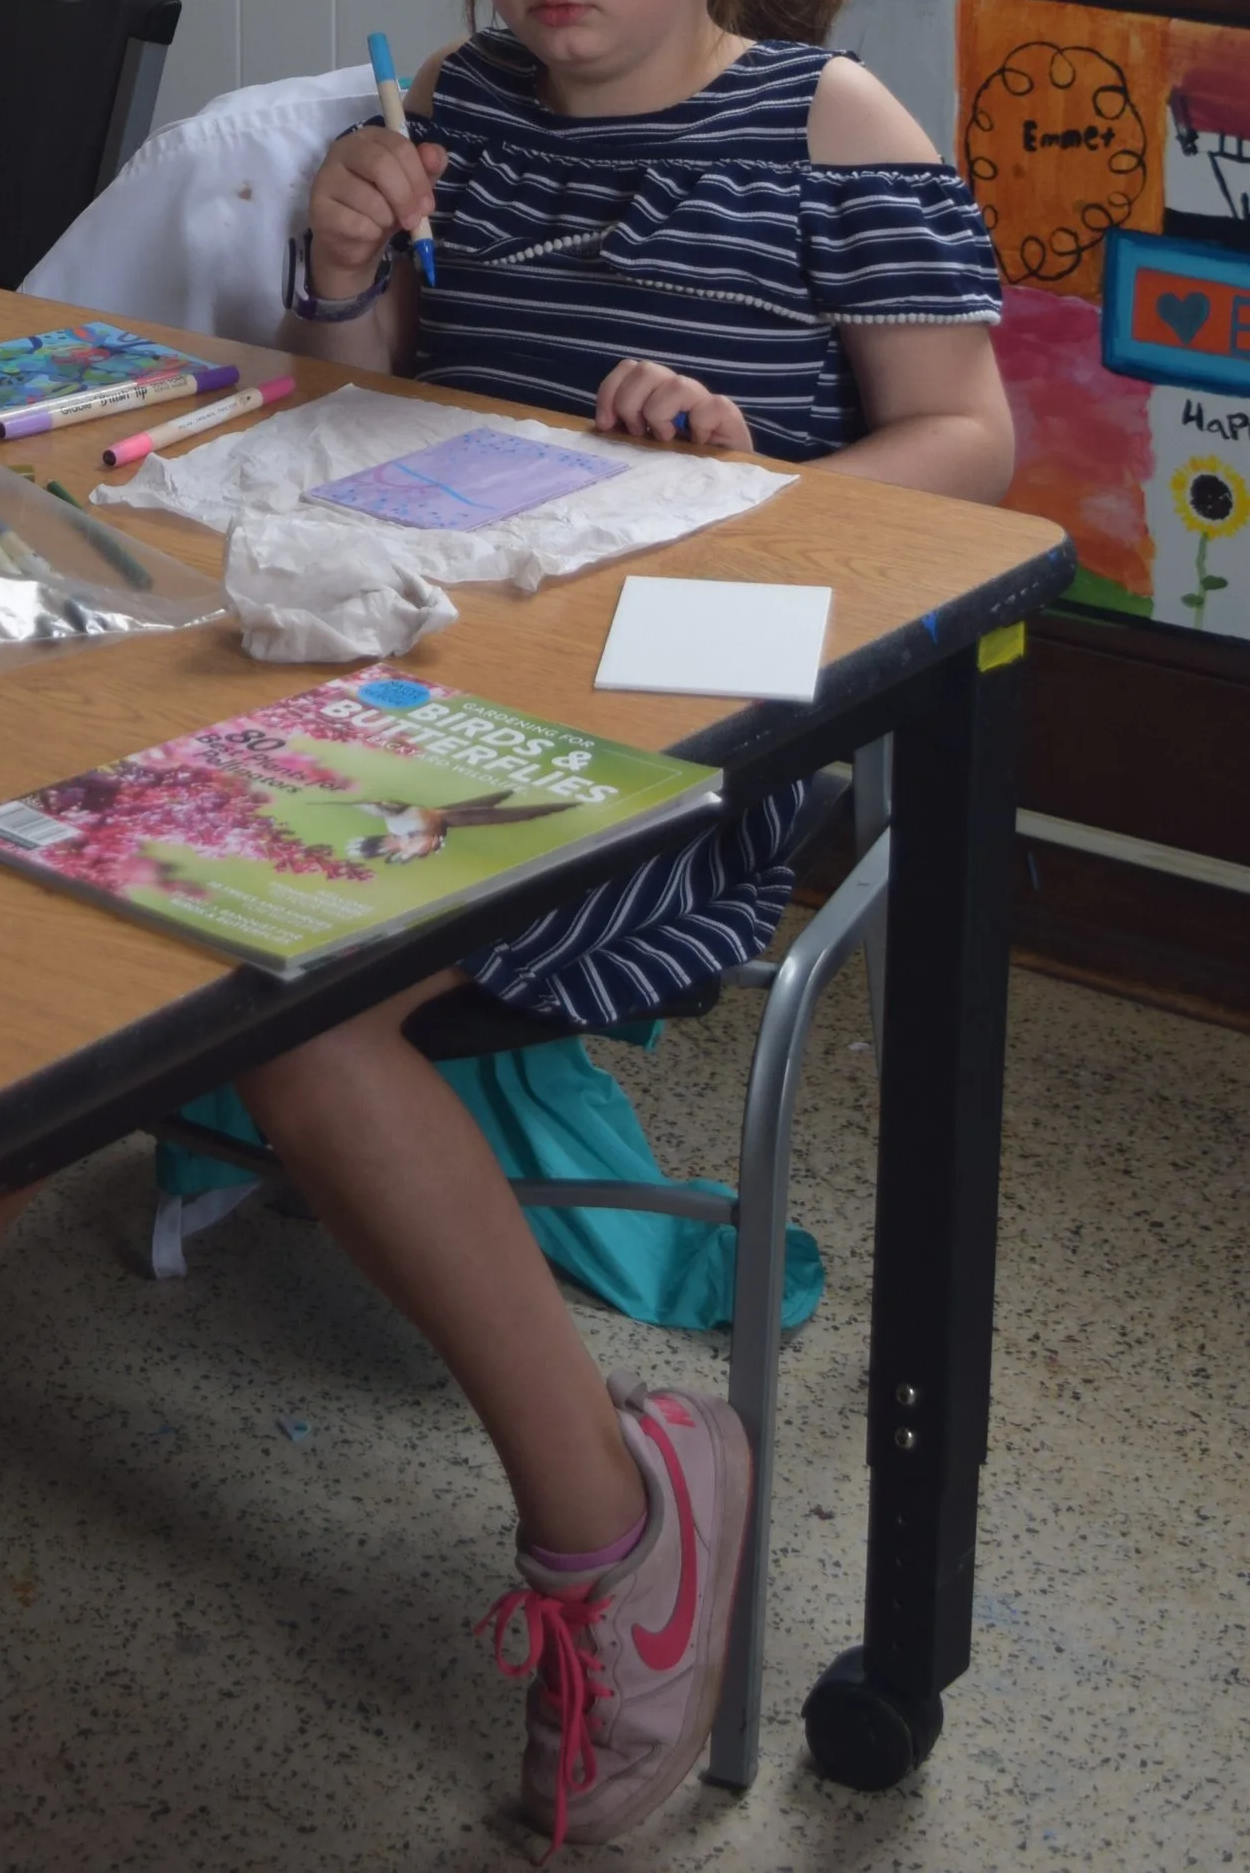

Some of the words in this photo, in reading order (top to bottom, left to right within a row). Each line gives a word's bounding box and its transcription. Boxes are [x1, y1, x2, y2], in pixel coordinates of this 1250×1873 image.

[224, 728, 287, 752] 80
[319, 698, 619, 804] BUTTERFLIES
[406, 702, 555, 757] BIRDS
[550, 750, 593, 772] &
[461, 702, 559, 738] GARDENING
[560, 732, 595, 749] FOR
